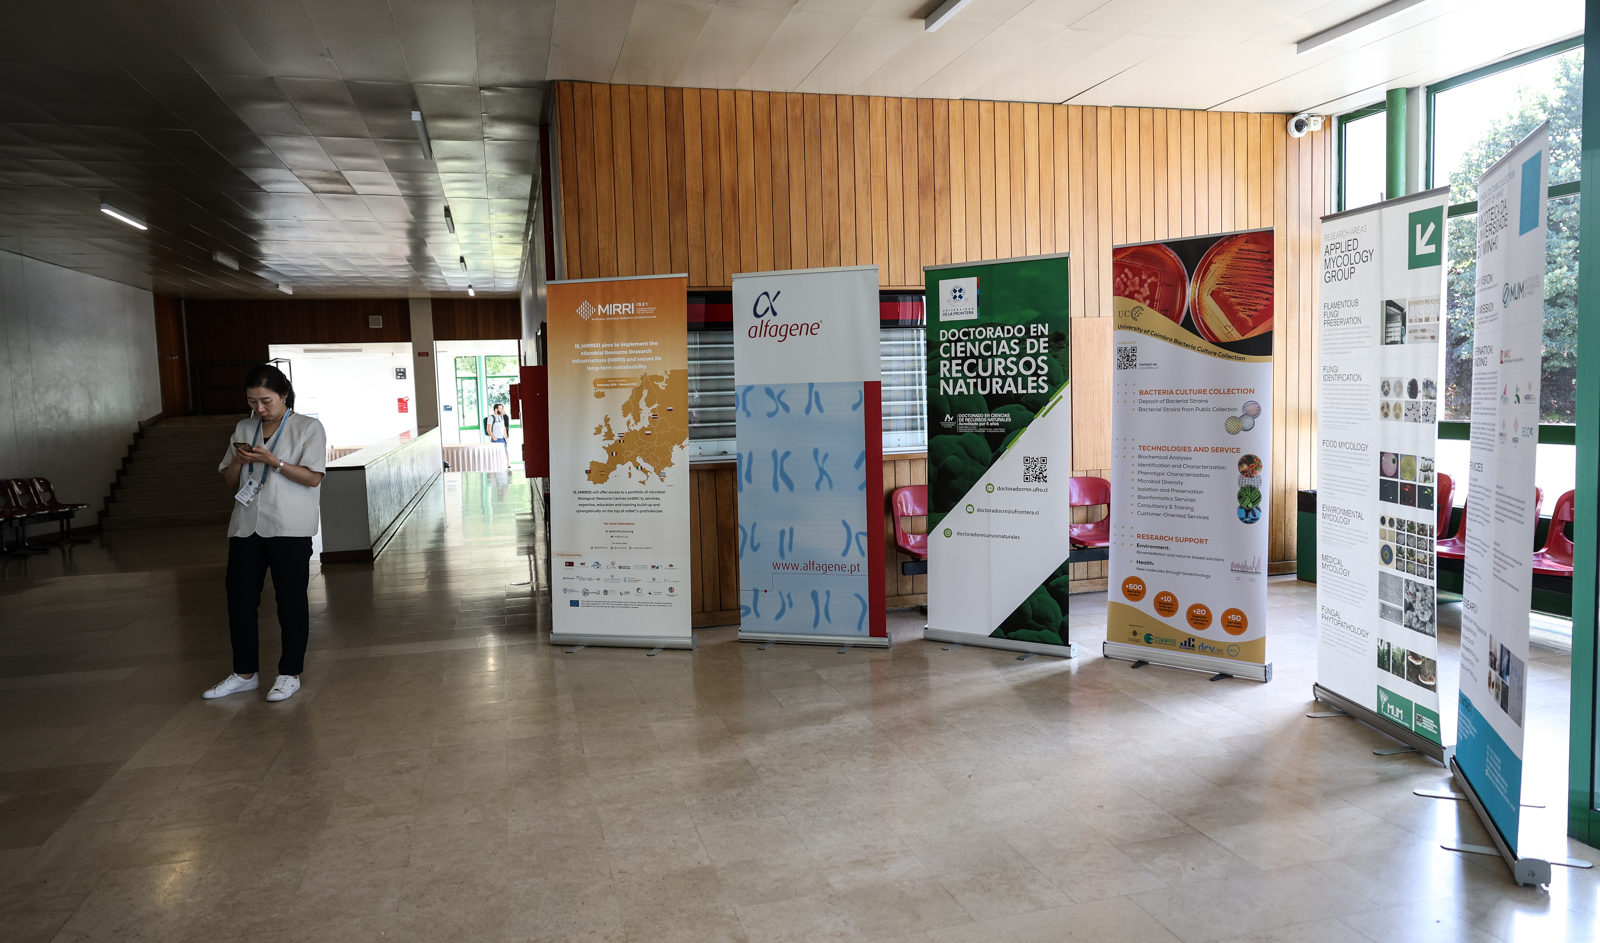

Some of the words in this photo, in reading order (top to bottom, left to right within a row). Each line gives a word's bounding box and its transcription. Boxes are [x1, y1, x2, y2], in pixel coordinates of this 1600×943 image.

[1324, 230, 1349, 241] RESEARCH
[1350, 225, 1367, 235] AREAS
[1324, 238, 1358, 256] APPLIED
[1324, 249, 1374, 270] MYCOLOGY
[1324, 267, 1355, 283] GROUP
[598, 303, 634, 315] MIRRI
[1324, 299, 1358, 310] FILAMENTOUS
[1324, 317, 1361, 327] PRESERVATION
[940, 325, 1025, 341] DOCTORADO
[1030, 324, 1048, 336] EN
[940, 340, 1020, 358] CIENCIAS
[1026, 338, 1048, 354] DE
[1118, 324, 1143, 333] University
[1150, 331, 1172, 342] Coimbra
[1174, 338, 1196, 350] Bacteria
[1197, 346, 1217, 356] Culture
[1218, 352, 1246, 361] Collection
[940, 356, 1049, 378] RECURSOS
[940, 376, 1049, 395] NATURALES
[1323, 439, 1337, 448] FOOD
[1339, 441, 1368, 452] MYCOLOGY
[1322, 504, 1364, 520] ENVIRONMENTAL
[1322, 512, 1351, 525] MYCOLOGY
[1137, 534, 1173, 542] RESEARCH
[772, 560, 860, 574] www.alfagene.pt
[1322, 554, 1343, 567] MEDICAL
[1322, 562, 1350, 577] MYCOLOGY
[1322, 606, 1341, 619] FUNGAL
[1322, 614, 1369, 638] PHYTOPATHOLOGY
